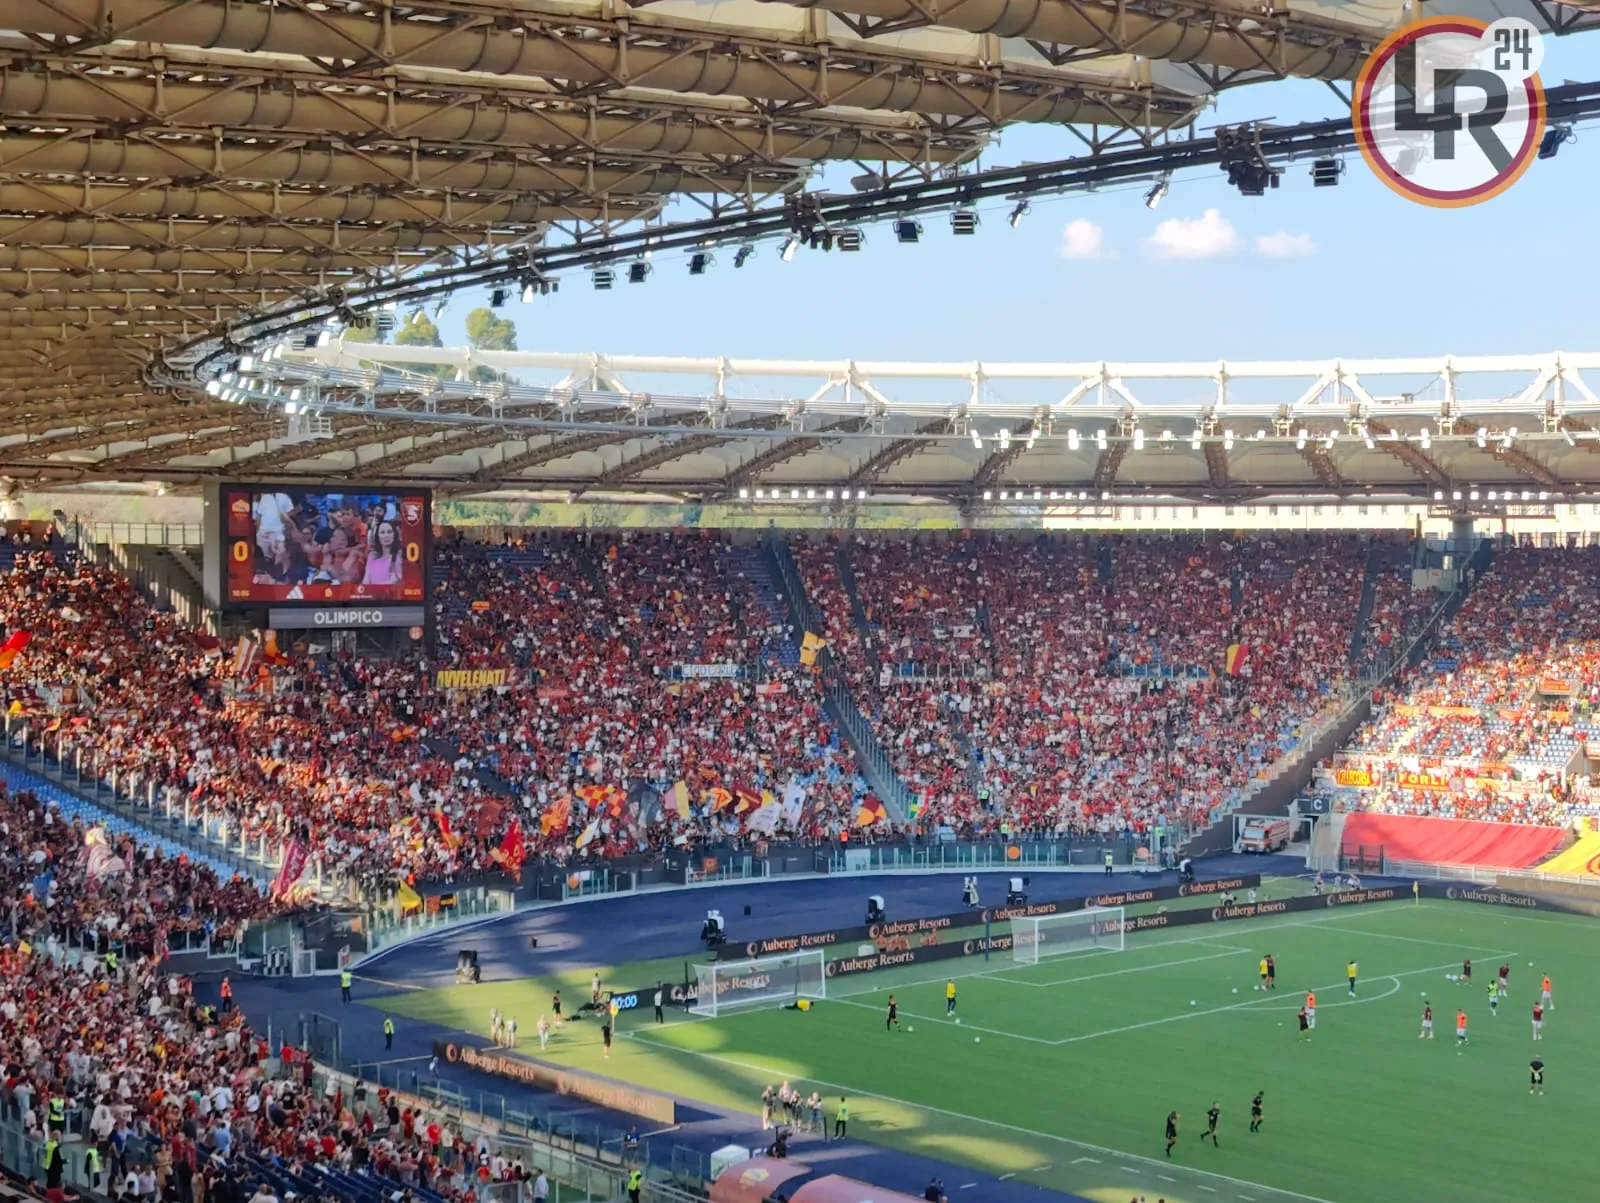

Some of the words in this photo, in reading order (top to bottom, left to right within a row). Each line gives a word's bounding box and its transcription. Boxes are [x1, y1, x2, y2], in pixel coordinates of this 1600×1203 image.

[233, 540, 249, 562] 0
[405, 541, 420, 563] 0
[314, 610, 383, 625] OLIMPICO
[1313, 798, 1323, 811] C
[1460, 888, 1499, 905] Auberge
[1500, 893, 1537, 908] Resorts
[993, 907, 1027, 921] Auberge
[1027, 902, 1057, 915] Resorts
[1224, 904, 1256, 918] Auberge
[1257, 900, 1287, 913] Resorts
[881, 921, 918, 935] Auberge
[918, 916, 951, 931] Resorts
[1137, 914, 1168, 929] Resorts
[760, 938, 800, 952] Auberge
[801, 932, 836, 947] Resorts
[839, 956, 879, 973] Auberge
[880, 950, 915, 966] Resorts
[499, 1057, 535, 1080] Resorts
